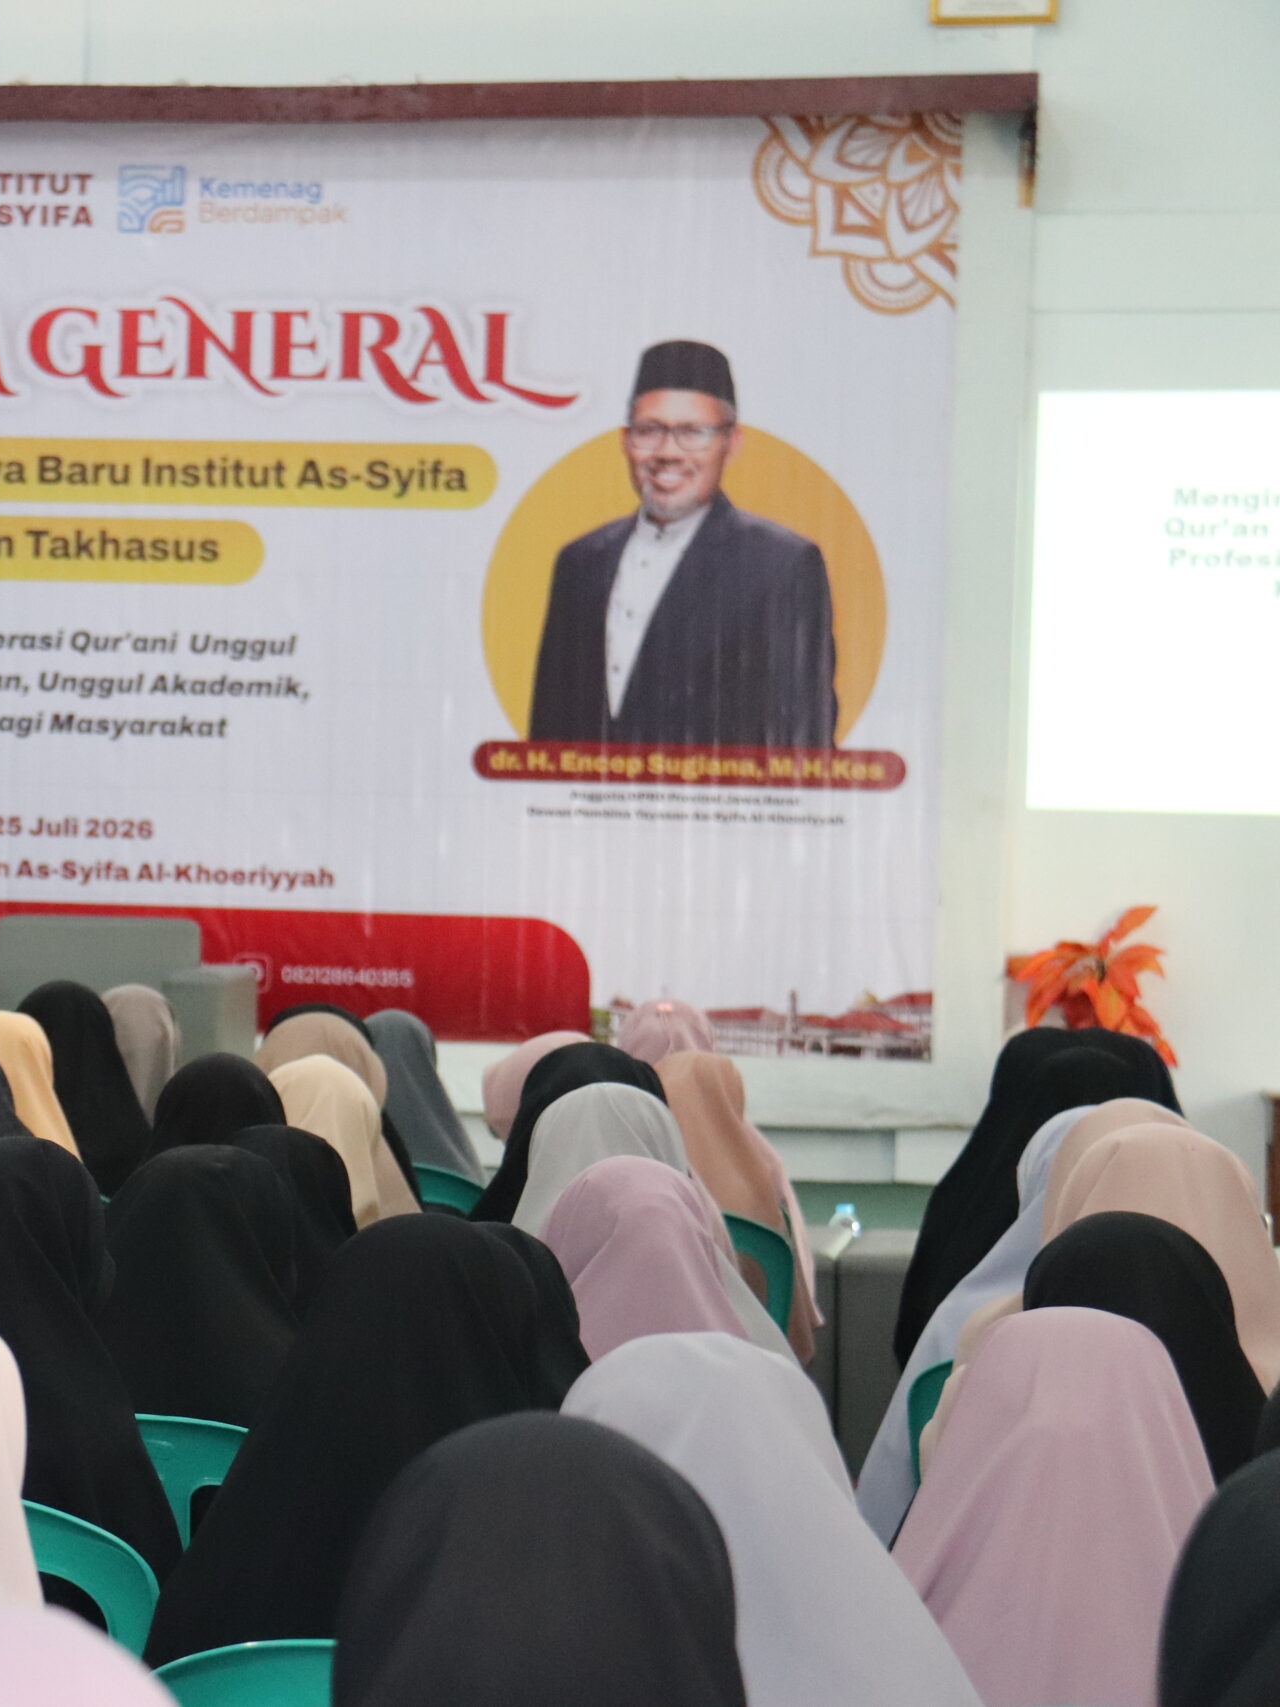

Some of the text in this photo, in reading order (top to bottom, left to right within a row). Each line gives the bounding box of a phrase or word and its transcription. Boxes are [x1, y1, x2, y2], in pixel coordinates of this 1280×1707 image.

[199, 178, 322, 205] Kemenag
[199, 202, 347, 225] Berdampak
[28, 296, 580, 408] GENERAL
[37, 456, 130, 486] Baru
[141, 458, 285, 489] Institut
[297, 460, 468, 498] As-Syifa
[27, 529, 220, 562] Takhasus
[70, 631, 178, 655] Qur'ani
[188, 633, 297, 661] Unggul
[38, 671, 143, 699] Unggul
[149, 674, 310, 702] Akademik,
[49, 713, 228, 740] Masyarakat
[526, 750, 556, 772] H.
[647, 752, 763, 781] Sugiana,
[29, 817, 79, 837] Juli
[85, 819, 154, 839] 2026
[16, 860, 129, 885] As-Syifa
[136, 862, 335, 892] Al-Khoeriyyah
